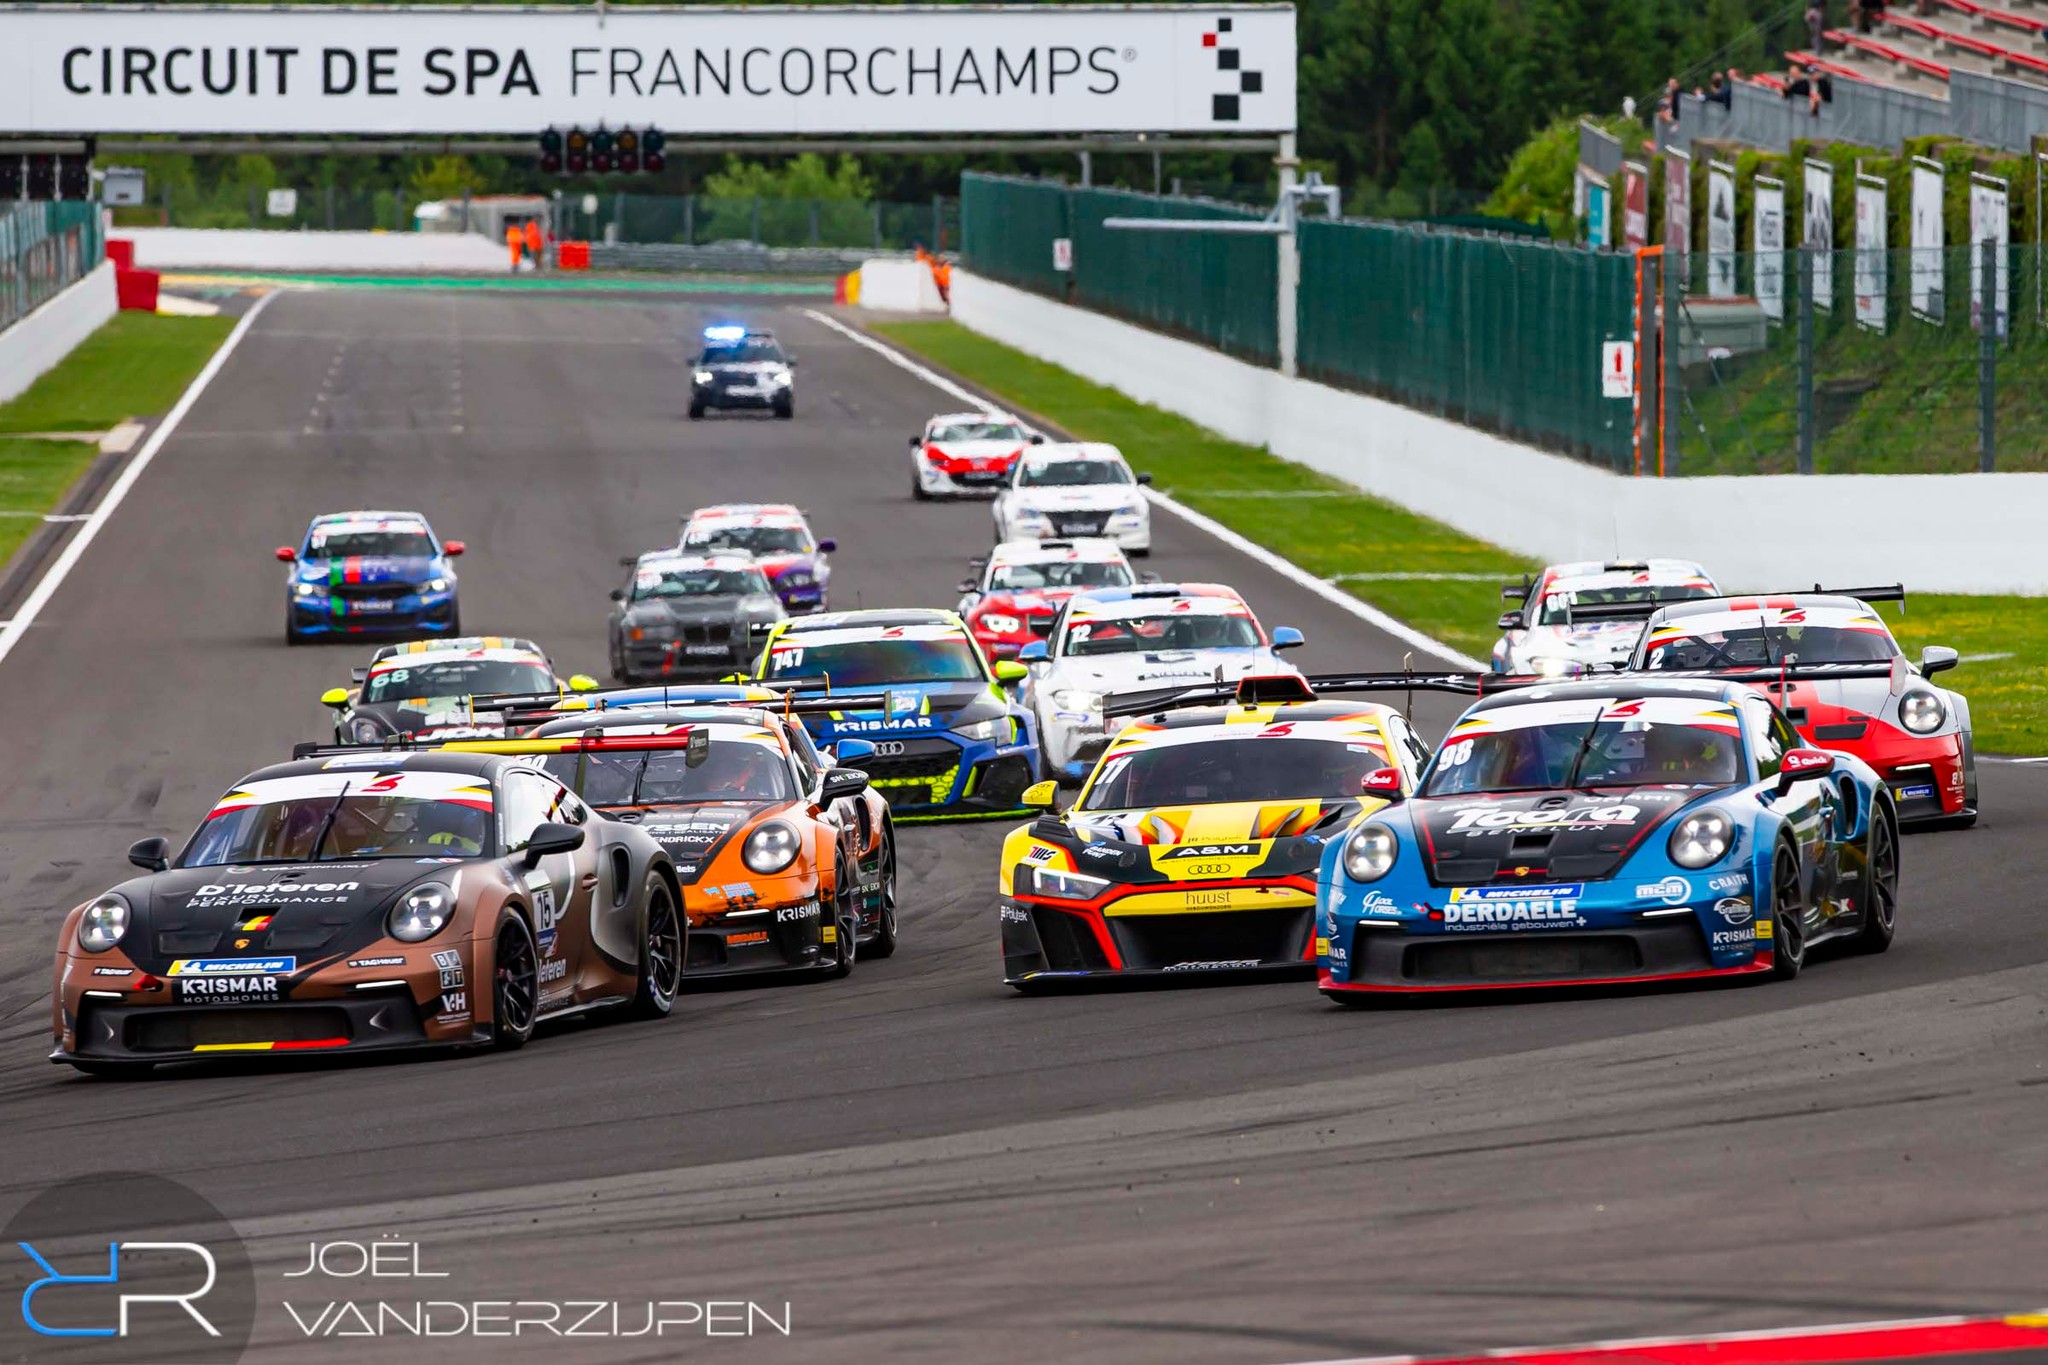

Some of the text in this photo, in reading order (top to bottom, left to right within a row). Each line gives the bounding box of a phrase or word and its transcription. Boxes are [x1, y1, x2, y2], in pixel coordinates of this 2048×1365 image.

[62, 46, 298, 96] CIRCUIT
[323, 47, 398, 96] DE
[424, 47, 540, 96] SPA
[1072, 625, 1091, 642] 12
[773, 648, 804, 671] 747
[1650, 647, 1663, 669] 2
[371, 669, 410, 690] 68
[833, 716, 932, 733] KRISMAR
[1438, 738, 1475, 771] 98
[1801, 755, 1828, 766] Quick
[1095, 757, 1133, 786] 11
[1465, 824, 1608, 838] BENELUX
[1176, 844, 1249, 857] A&M
[1709, 873, 1750, 891] CRAITH
[190, 893, 276, 903] LUXURY
[1186, 890, 1232, 905] huust
[1485, 887, 1574, 899] MICHELIN
[186, 896, 349, 908] PERFORMANCE
[537, 890, 552, 930] 15
[776, 902, 822, 923] KRISMAR
[1443, 899, 1578, 923] DERDAELE
[1444, 920, 1575, 931] industriële gebouwen
[1713, 927, 1756, 944] KRISMAR
[203, 961, 284, 972] MICHELIN
[181, 976, 278, 994] KRISMAR
[183, 993, 280, 1004] MOTORHOMES
